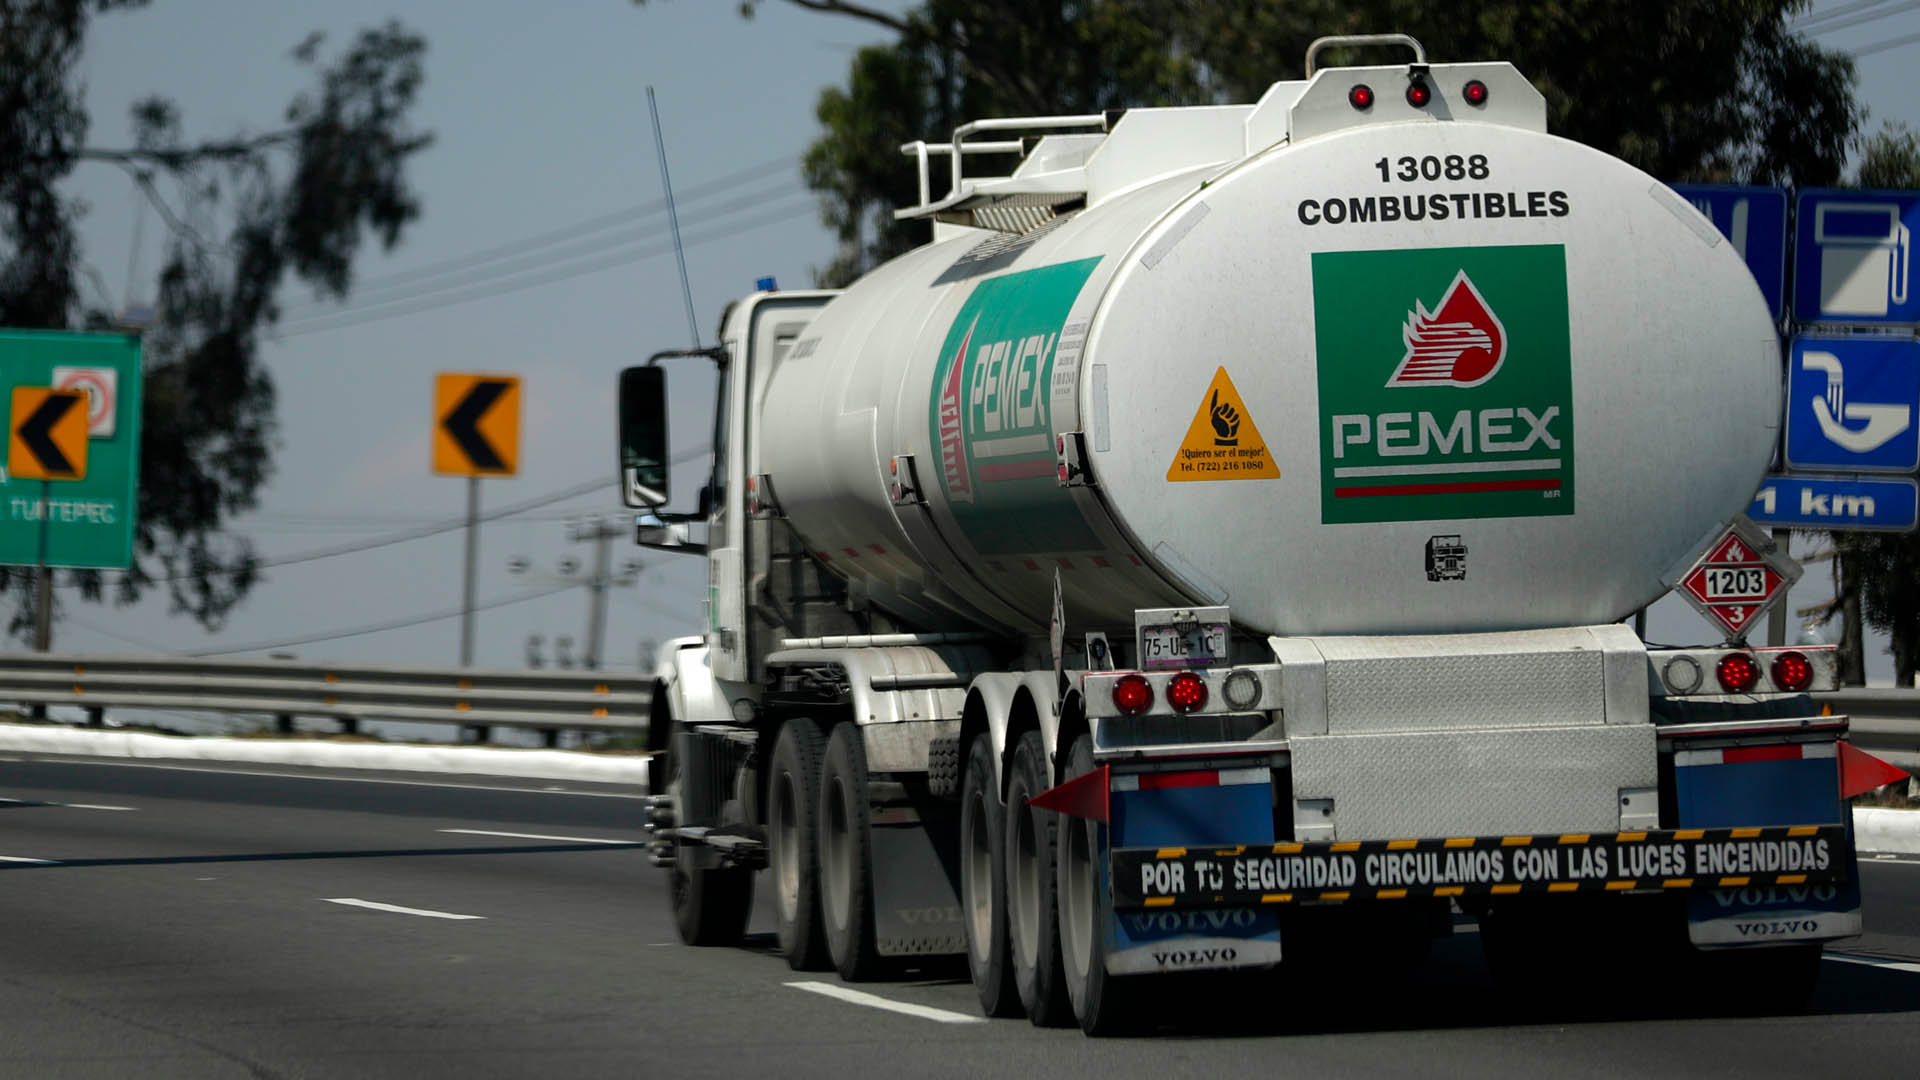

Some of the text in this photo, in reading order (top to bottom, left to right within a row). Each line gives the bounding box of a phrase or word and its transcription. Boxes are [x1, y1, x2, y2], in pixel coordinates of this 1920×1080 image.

[1375, 154, 1490, 182] 13088
[1297, 190, 1570, 226] COMBUSTIBLES
[970, 332, 1057, 434] PEMEX
[1331, 406, 1561, 459] PEMEX
[1214, 448, 1226, 458] ser
[1228, 447, 1236, 457] el
[1181, 462, 1195, 472] Tel.
[1197, 462, 1220, 473] (722)
[1223, 461, 1239, 471] 216
[1755, 486, 1875, 517] 1 km
[1708, 570, 1764, 595] 1203
[1729, 606, 1745, 624] 3
[1141, 838, 1830, 895] POR TU SEGURIDAD CIRCULAMOS CON LAS LUCES ENCENDIDAS
[1712, 886, 1837, 907] VOLVO
[1132, 907, 1257, 933] VOLVO
[1735, 919, 1818, 936] VOLVO
[1154, 948, 1237, 967] VOLVO
